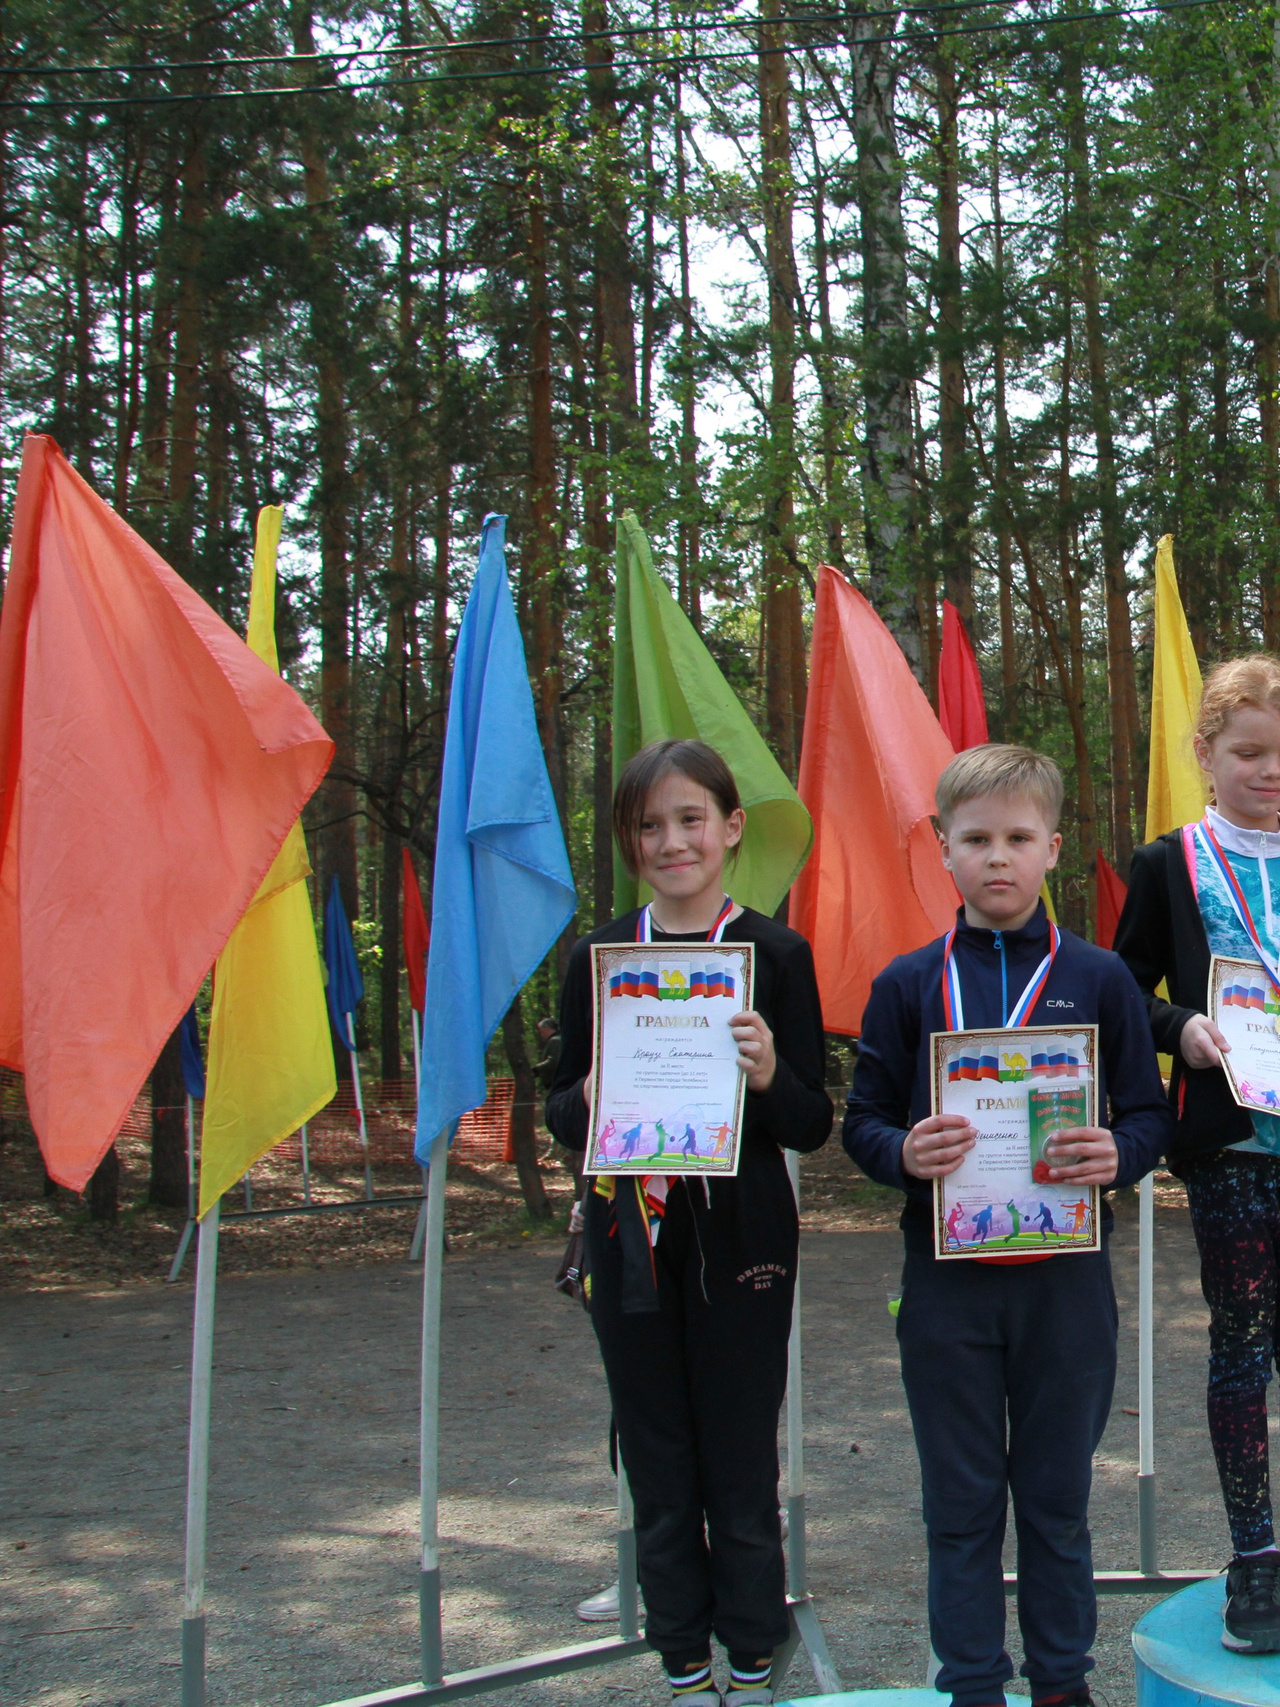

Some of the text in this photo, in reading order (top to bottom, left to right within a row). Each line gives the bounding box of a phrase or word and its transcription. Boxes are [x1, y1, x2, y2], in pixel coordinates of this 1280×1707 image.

[636, 1015, 710, 1028] ГРАМОТА
[736, 1263, 787, 1283] DREAMER
[754, 1281, 772, 1290] DAY
